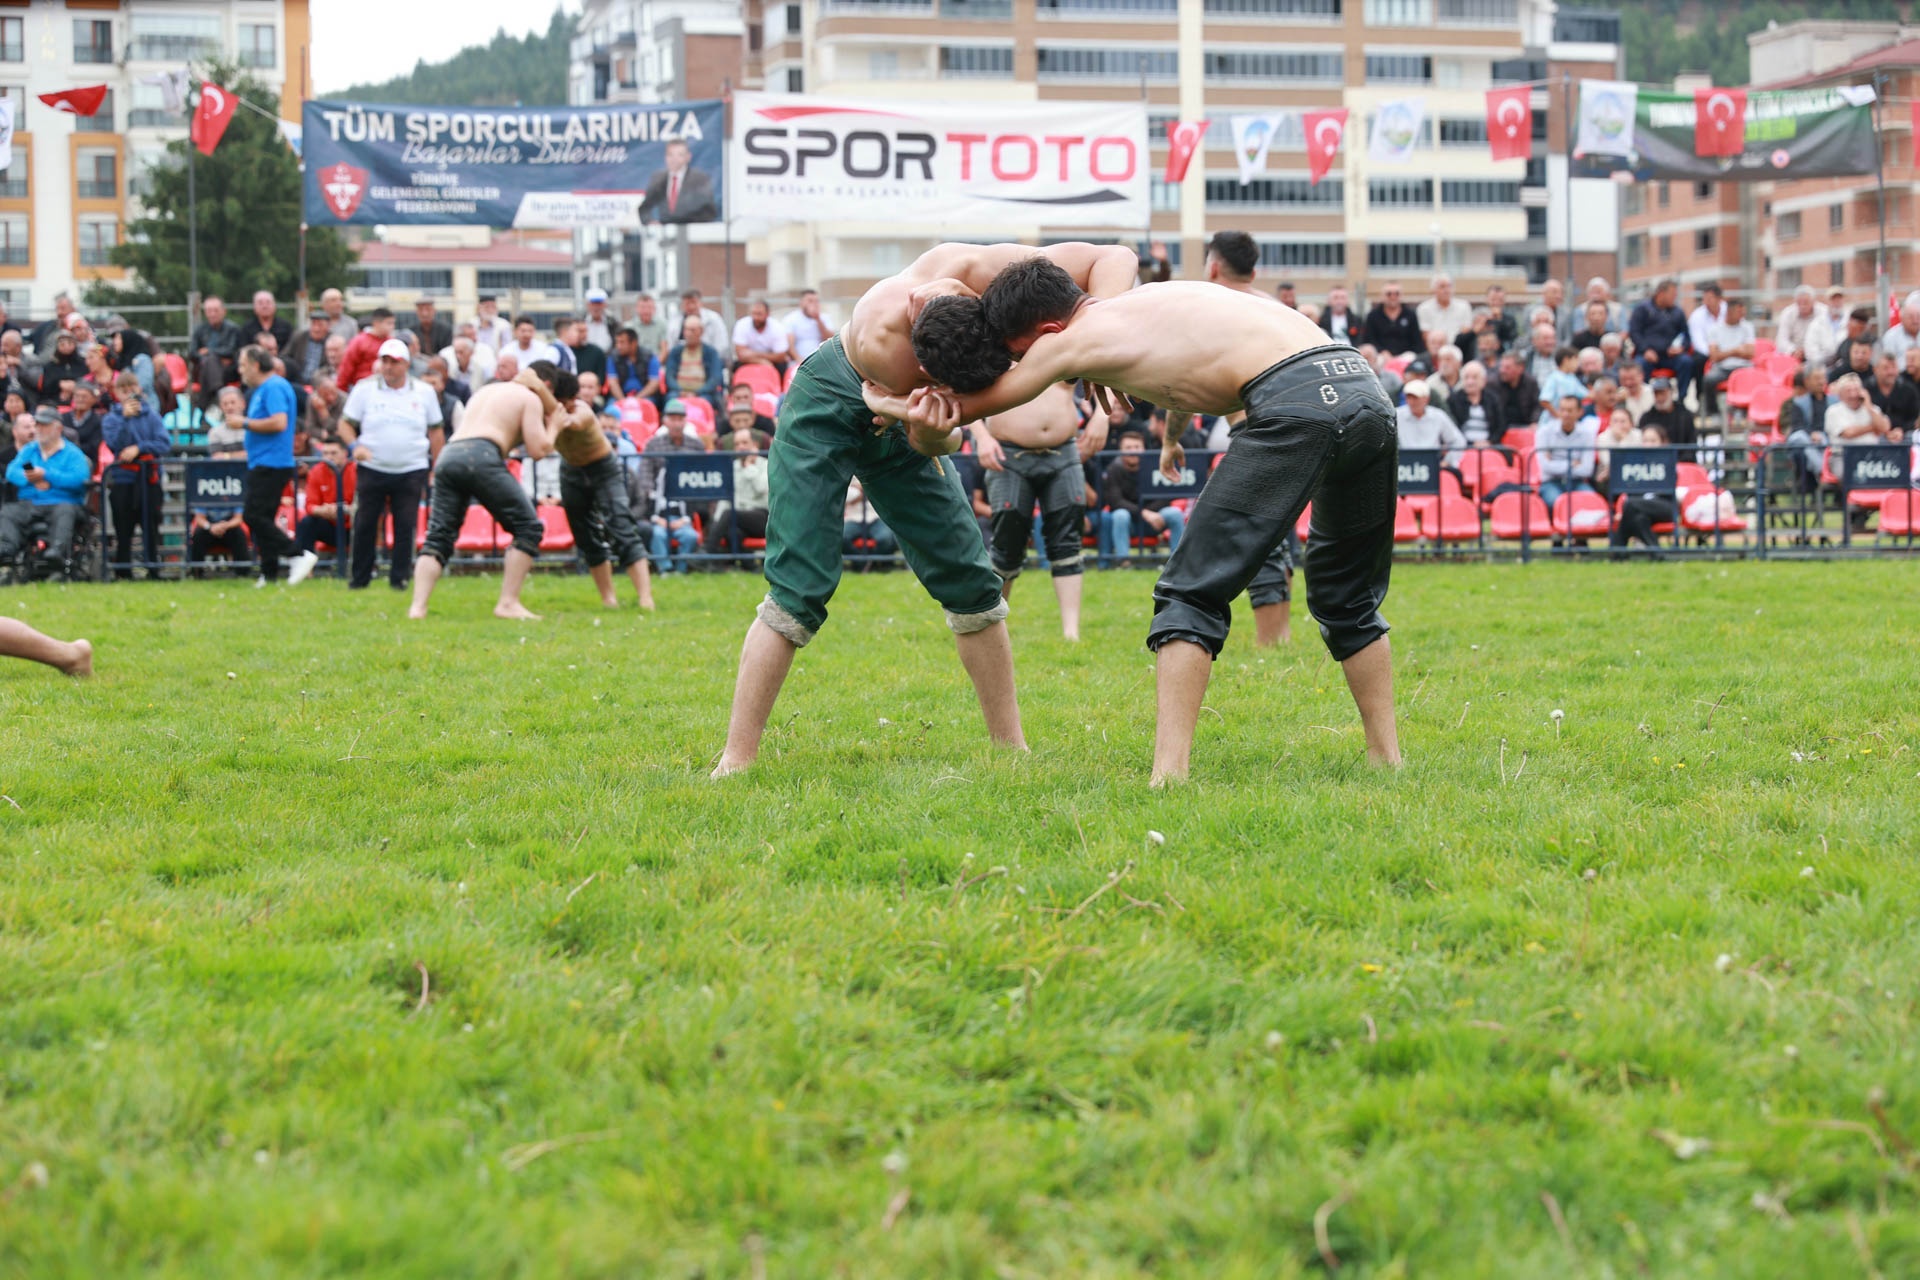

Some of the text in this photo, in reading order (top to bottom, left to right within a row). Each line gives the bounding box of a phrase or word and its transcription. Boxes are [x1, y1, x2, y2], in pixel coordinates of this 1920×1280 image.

[322, 105, 704, 143] TÜM SPORCULARIMIZA
[401, 133, 629, 170] Başarılar Dilerim
[197, 475, 242, 496] POLİS
